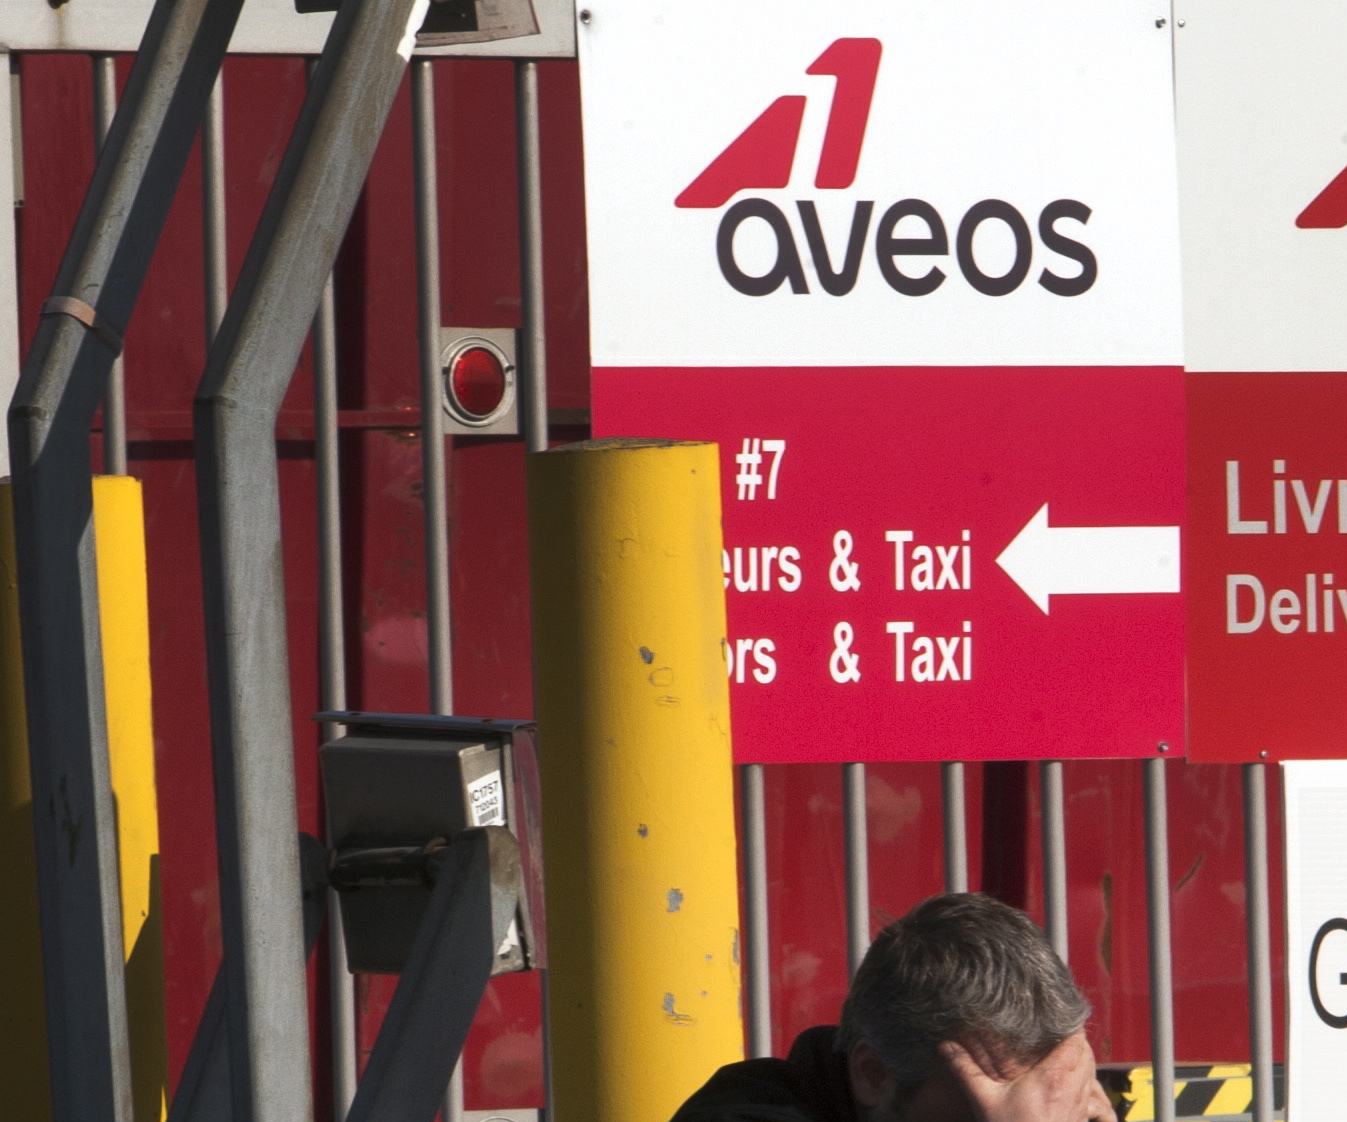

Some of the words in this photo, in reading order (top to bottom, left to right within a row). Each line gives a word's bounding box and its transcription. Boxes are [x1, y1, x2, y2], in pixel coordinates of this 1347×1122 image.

[716, 197, 1098, 297] aveos
[735, 437, 786, 501] #7
[828, 529, 861, 593] &
[885, 529, 971, 592] Taxi
[829, 621, 862, 684] &
[885, 620, 972, 683] Taxi
